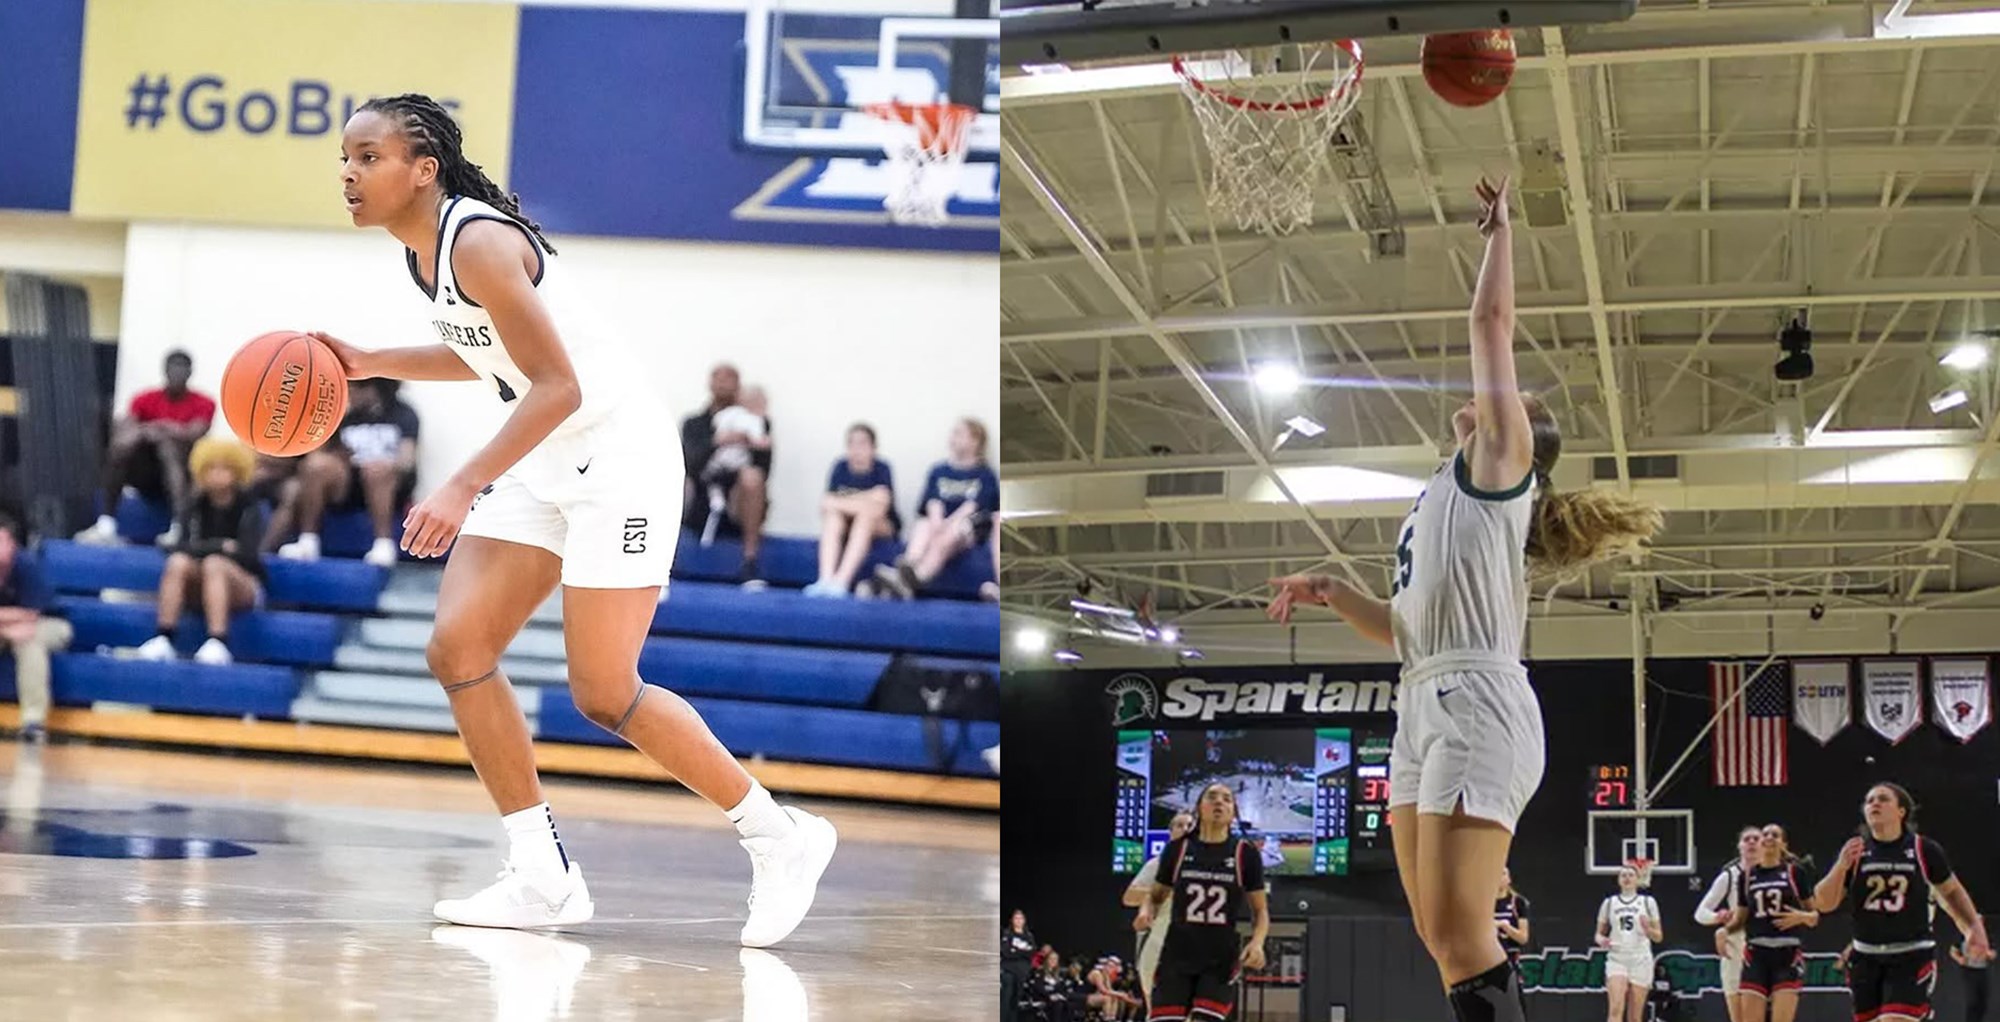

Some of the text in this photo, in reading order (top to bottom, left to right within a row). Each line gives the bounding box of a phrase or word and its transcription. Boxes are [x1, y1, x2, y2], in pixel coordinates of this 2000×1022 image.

[123, 72, 463, 137] #GoB
[264, 362, 305, 442] SPALDING
[623, 517, 648, 554] CSU
[1364, 779, 1391, 801] 37
[1596, 781, 1626, 806] 27
[1186, 883, 1228, 925] 22
[1754, 888, 1783, 918] 13
[1863, 873, 1909, 913] 23
[1619, 915, 1634, 932] 15
